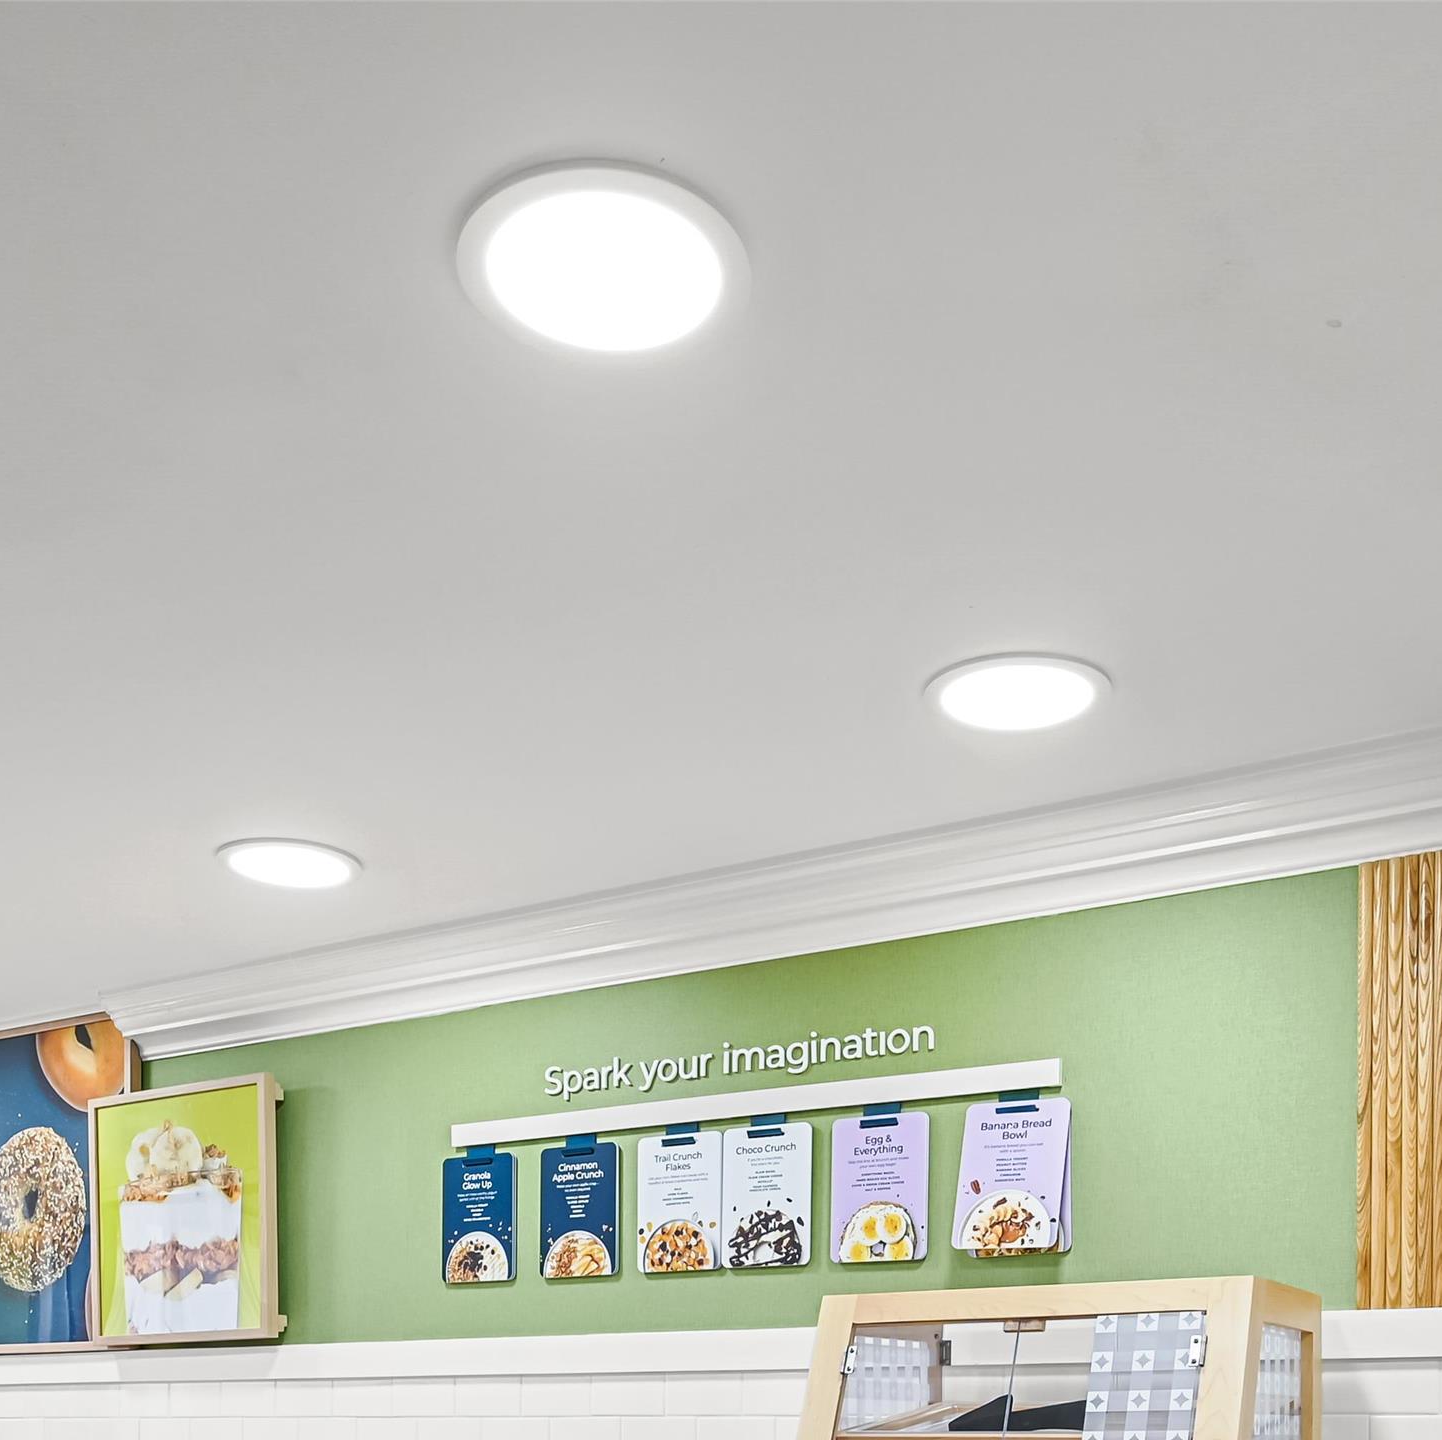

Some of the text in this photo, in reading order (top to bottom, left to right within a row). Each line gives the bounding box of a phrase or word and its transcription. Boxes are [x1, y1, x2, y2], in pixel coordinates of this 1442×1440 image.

[543, 1024, 936, 1101] Spark your imagination
[980, 1118, 1052, 1131] Banana Bread
[865, 1134, 892, 1146] Egg &
[1002, 1130, 1028, 1140] Bowl
[735, 1142, 797, 1156] Choco Crunch
[853, 1144, 904, 1156] Everything
[654, 1151, 703, 1163] Trail Crunch
[557, 1162, 599, 1172] Cinnamon
[665, 1163, 692, 1172] Flakes
[463, 1171, 492, 1182] Granola
[552, 1169, 604, 1183] Apple Crunch
[462, 1181, 493, 1191] Glow Up
